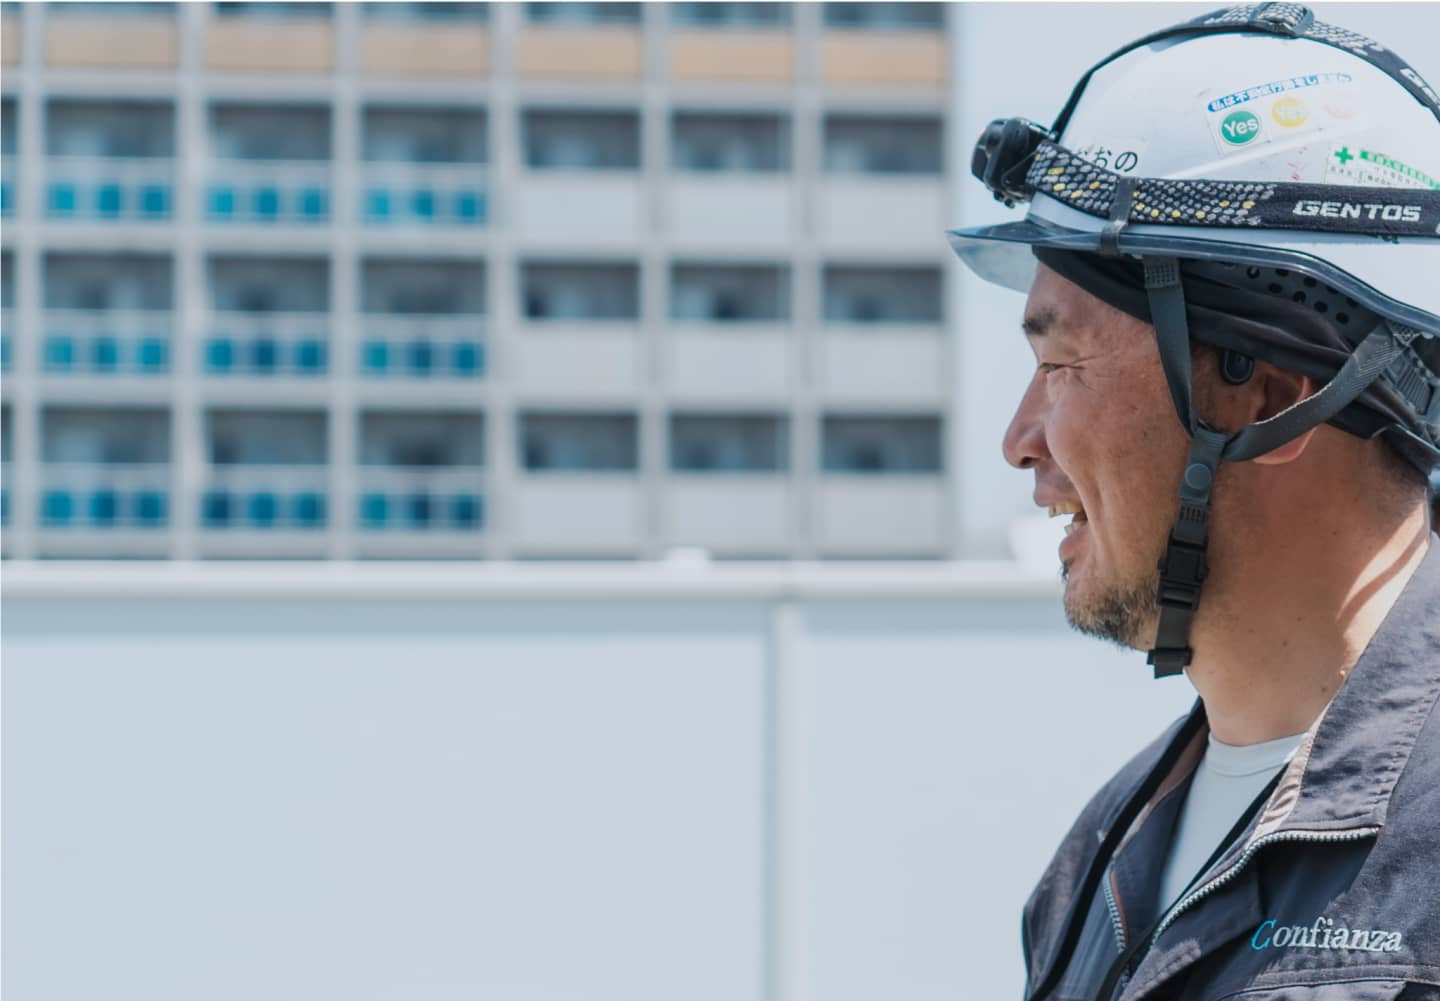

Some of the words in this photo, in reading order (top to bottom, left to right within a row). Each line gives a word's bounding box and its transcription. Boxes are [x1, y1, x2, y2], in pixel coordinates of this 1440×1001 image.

[1223, 119, 1258, 138] Yes
[1078, 146, 1139, 173] おの
[1292, 200, 1422, 222] GENTOS
[1251, 916, 1403, 952] Confianza
